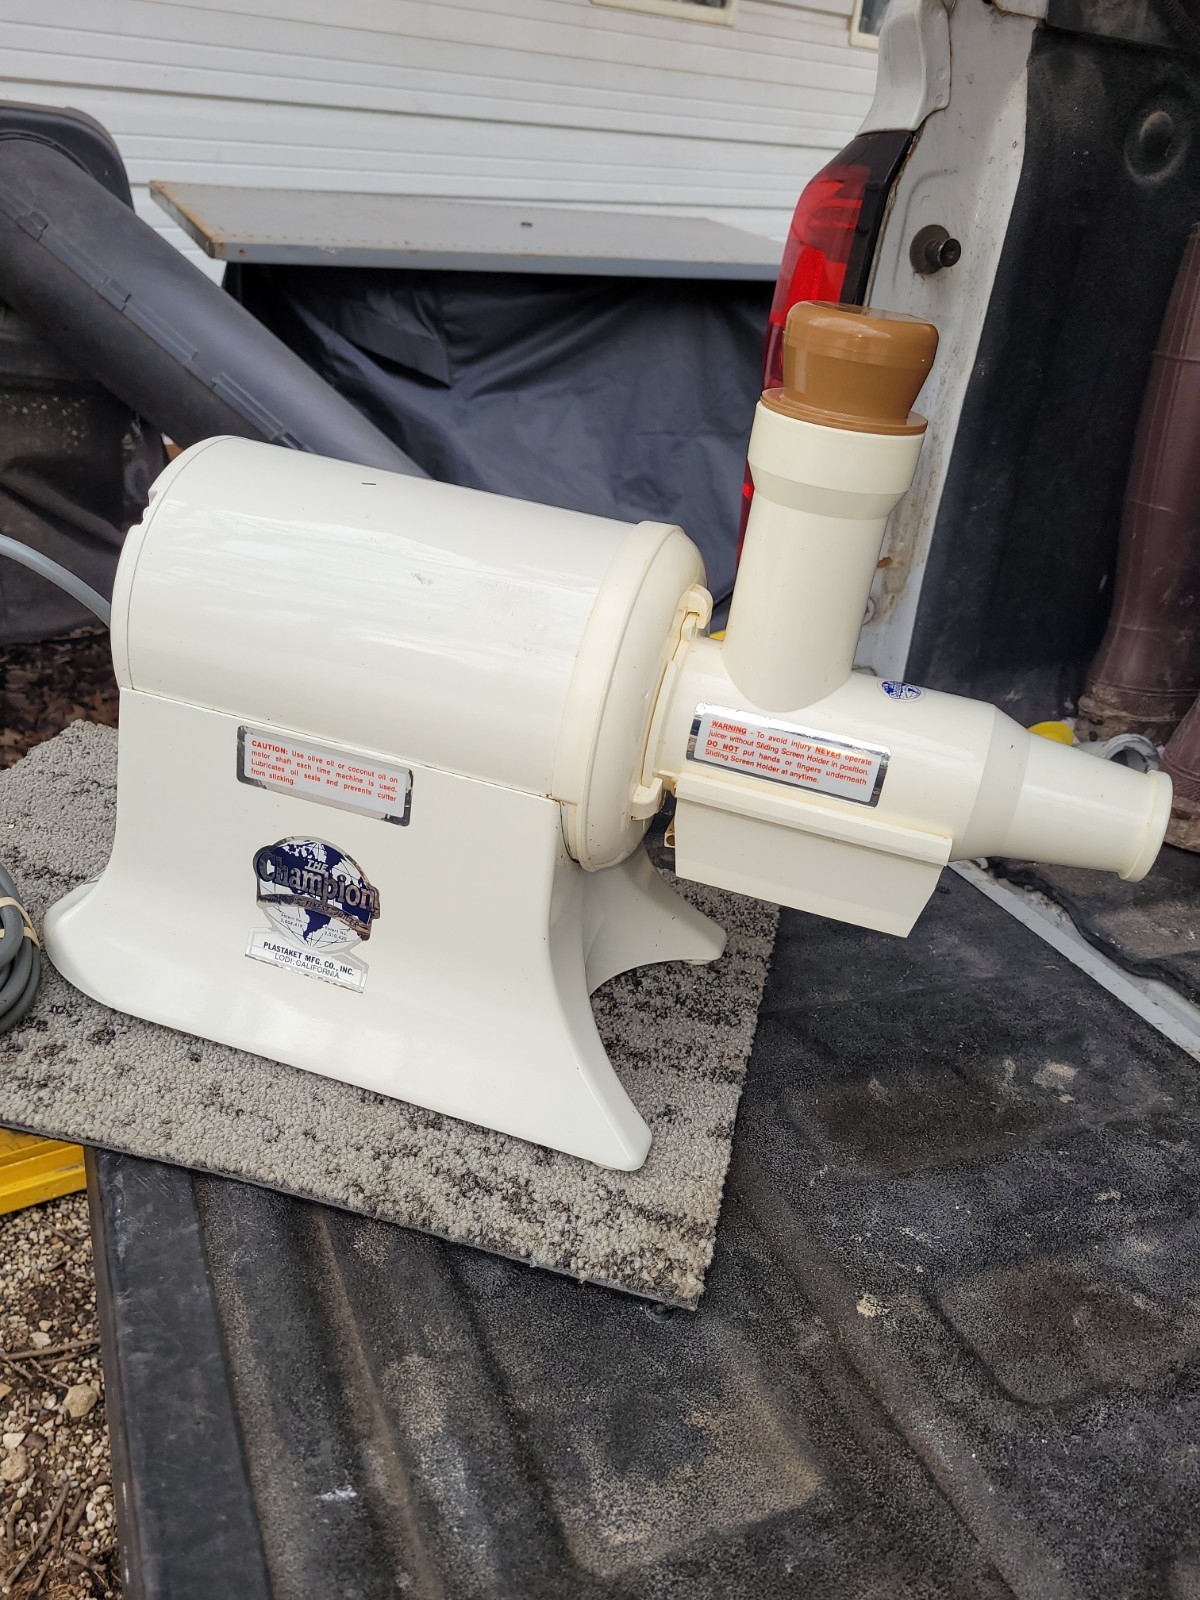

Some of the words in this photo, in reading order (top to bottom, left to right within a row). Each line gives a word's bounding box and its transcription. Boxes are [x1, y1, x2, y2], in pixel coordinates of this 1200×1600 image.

[252, 741, 288, 755] CAUTION:
[292, 751, 304, 759] Use
[308, 756, 322, 764] olive
[348, 767, 374, 777] coconut
[709, 730, 727, 740] juicer
[730, 736, 754, 746] without
[756, 742, 779, 754] Sliding
[781, 748, 804, 760] Screen
[807, 755, 829, 766] Holder
[839, 763, 868, 776] position.
[712, 720, 747, 735] WARNING
[769, 736, 787, 744] avoid
[791, 740, 811, 752] injury
[815, 746, 842, 759] NEVER
[845, 755, 872, 766] operate
[251, 768, 265, 777] from
[269, 773, 295, 785] sticking.
[252, 751, 270, 759] motor
[276, 756, 292, 765] shaft
[297, 762, 312, 770] each
[317, 767, 331, 775] time
[336, 772, 363, 783] machine
[380, 784, 397, 793] used.
[252, 759, 285, 773] Lubricates
[304, 773, 321, 782] seals
[344, 784, 372, 795] prevents
[378, 793, 397, 802] cutter
[705, 749, 729, 761] Sliding
[731, 756, 754, 767] Screen
[757, 763, 779, 773] Holder
[790, 772, 819, 783] anytime.
[723, 744, 739, 752] NOT
[759, 753, 780, 763] hands
[797, 763, 821, 774] fingers
[826, 770, 867, 785] underneath
[257, 851, 375, 911] Champion
[305, 859, 329, 871] THE
[306, 901, 329, 911] FINEST
[263, 942, 304, 959] PLASTAKET
[304, 954, 322, 966] MFG.
[340, 966, 354, 976] INC.
[296, 959, 340, 979] CALIFORNIA
